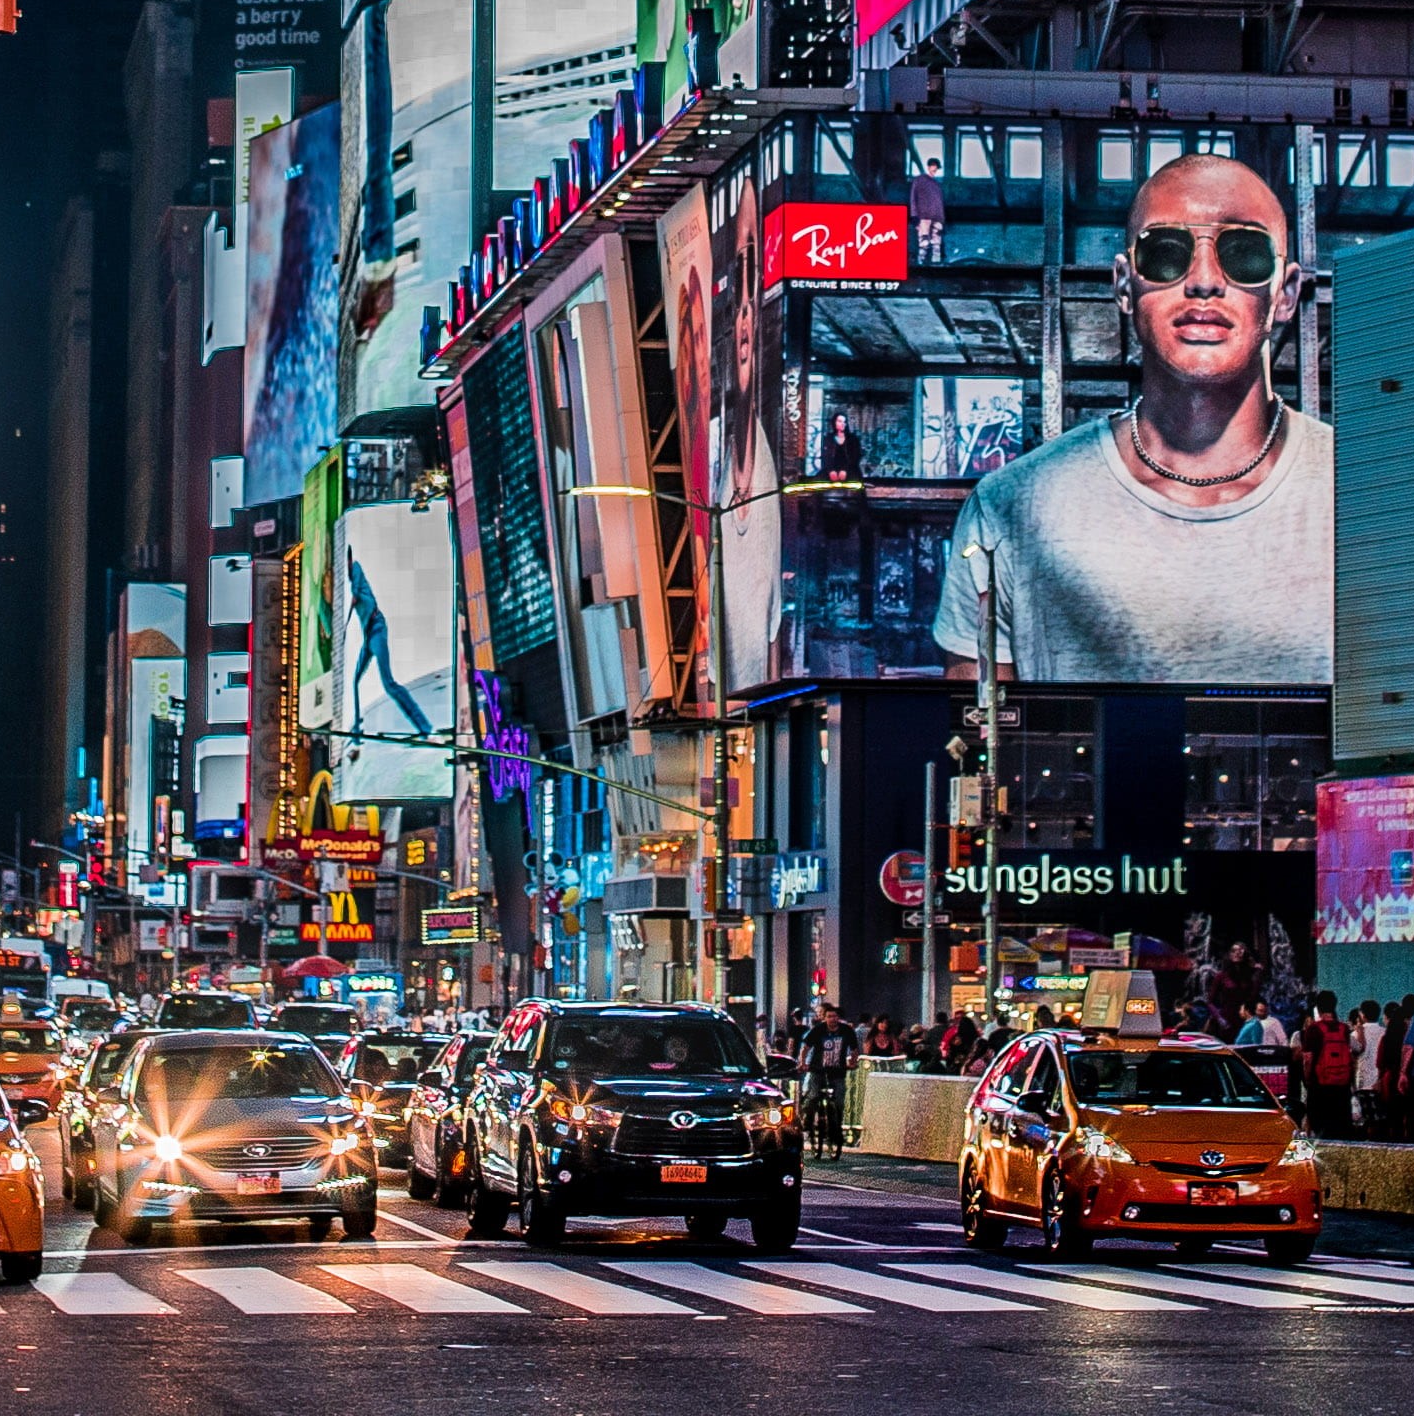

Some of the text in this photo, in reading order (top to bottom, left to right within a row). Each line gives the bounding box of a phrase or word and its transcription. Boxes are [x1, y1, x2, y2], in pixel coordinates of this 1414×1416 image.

[236, 7, 302, 27] a berry
[235, 28, 320, 50] good time
[792, 212, 899, 269] Ray-Ban
[300, 839, 381, 852] McDonald's
[945, 854, 1188, 905] sunglass hut
